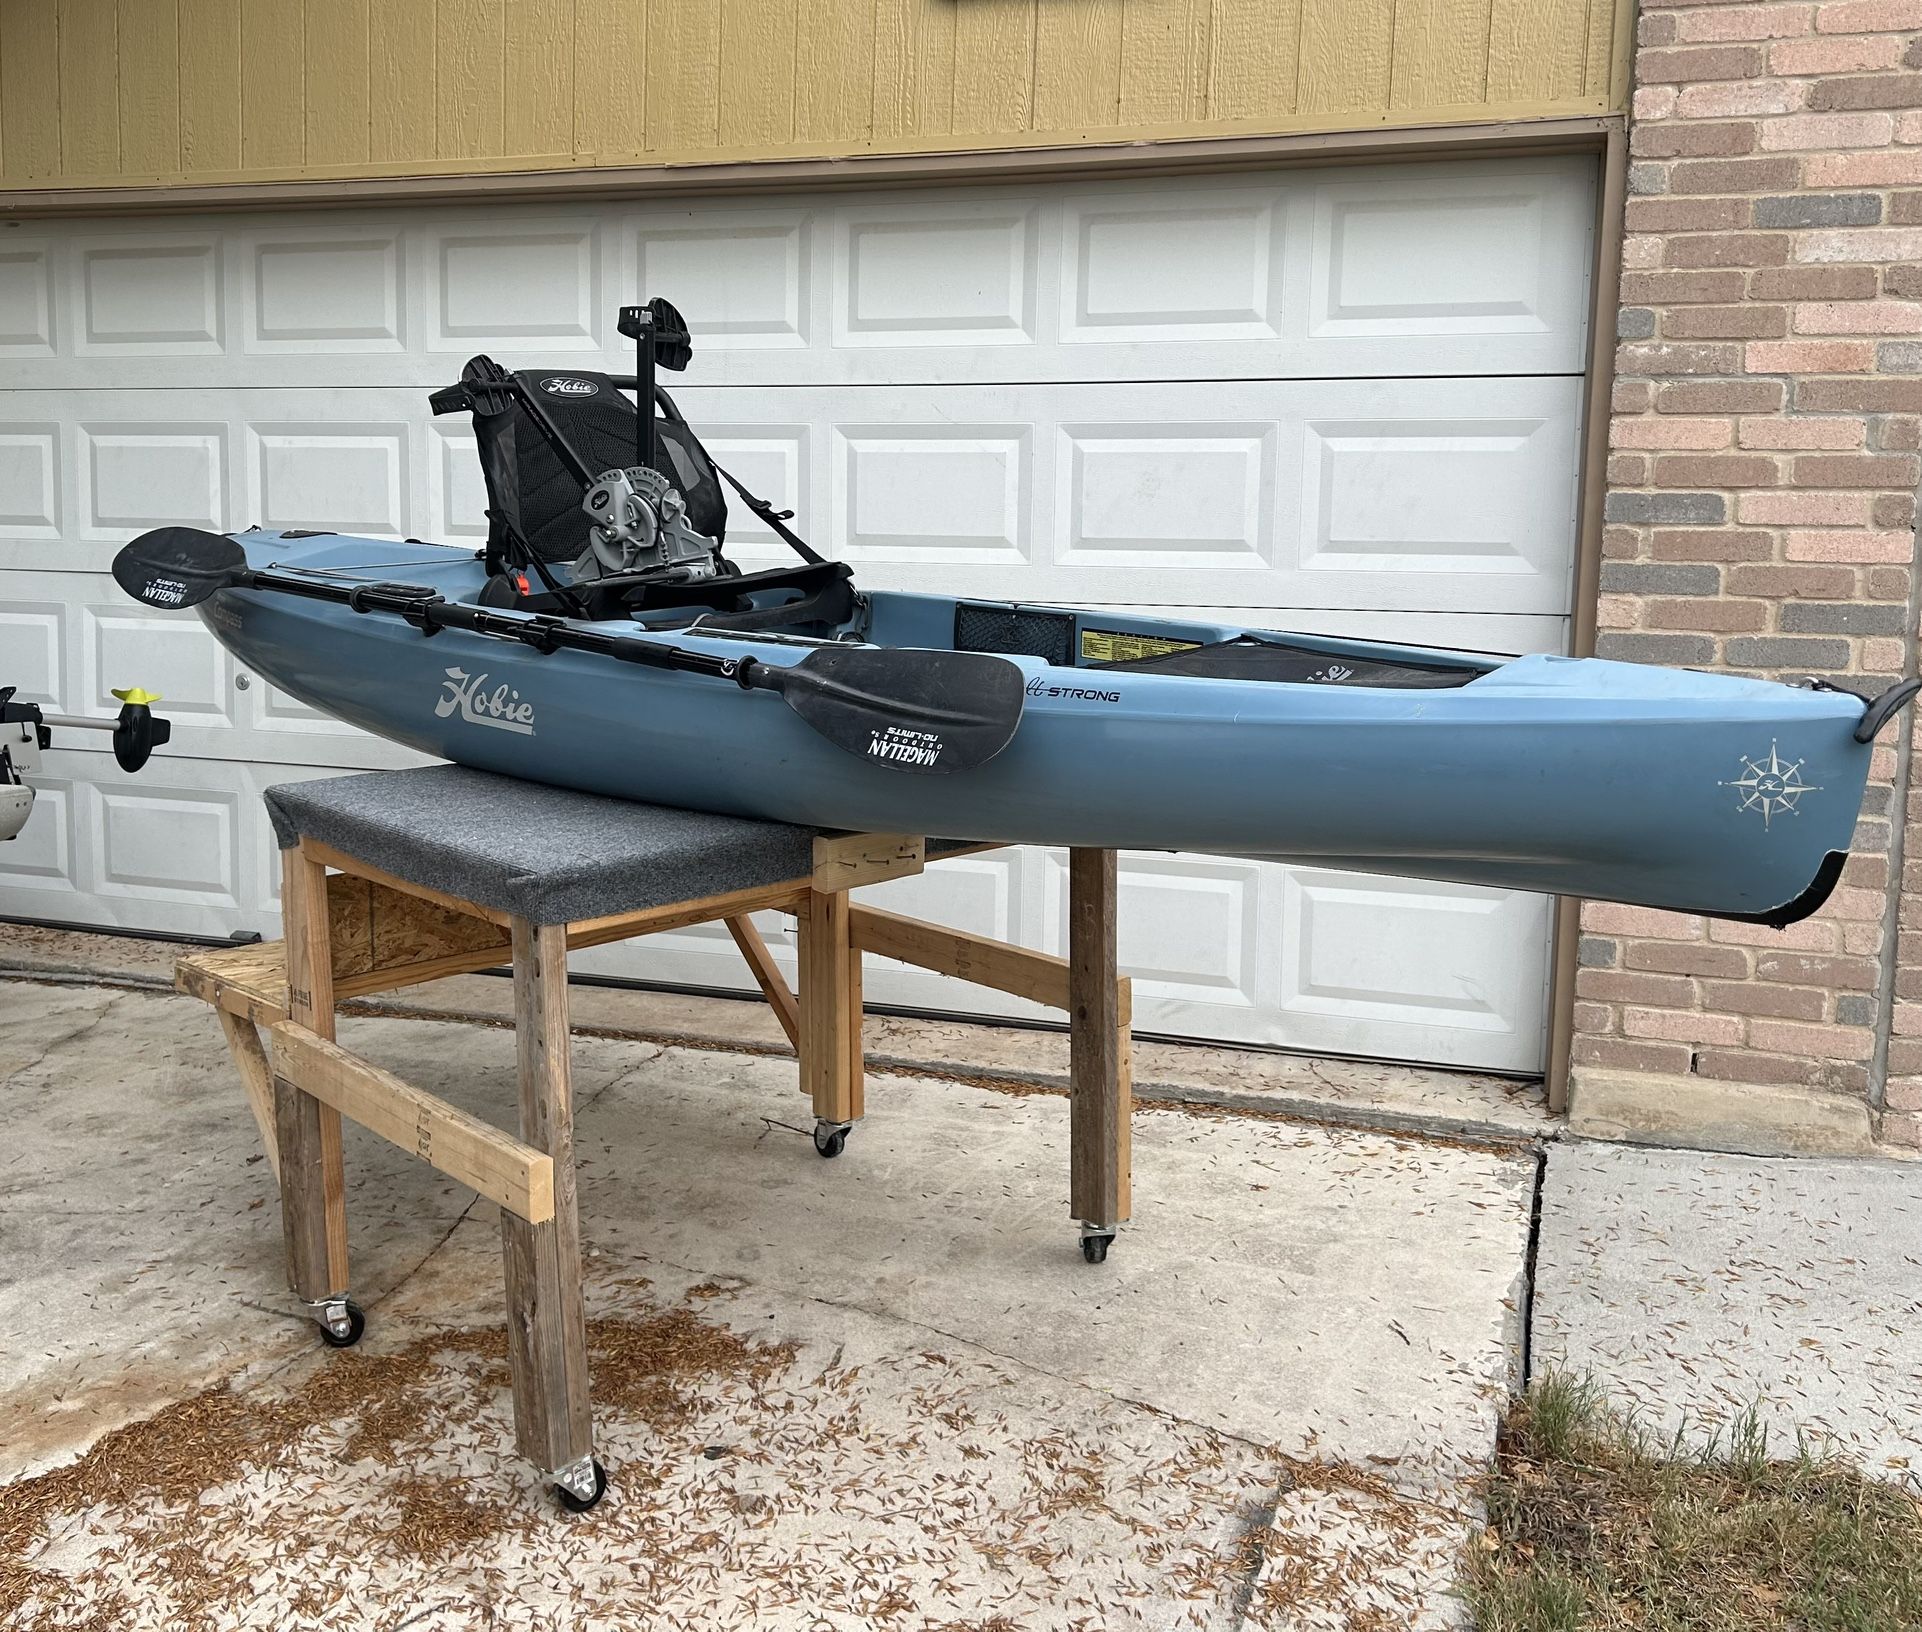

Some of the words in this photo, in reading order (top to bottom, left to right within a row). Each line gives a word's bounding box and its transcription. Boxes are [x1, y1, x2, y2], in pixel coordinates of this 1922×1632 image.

[547, 379, 592, 393] Hobie
[141, 586, 185, 604] MAGELLAN
[434, 666, 536, 736] Hobie
[1047, 686, 1121, 703] STRONG
[874, 731, 943, 750] OUTDOORS
[867, 738, 940, 766] MAGELLAN
